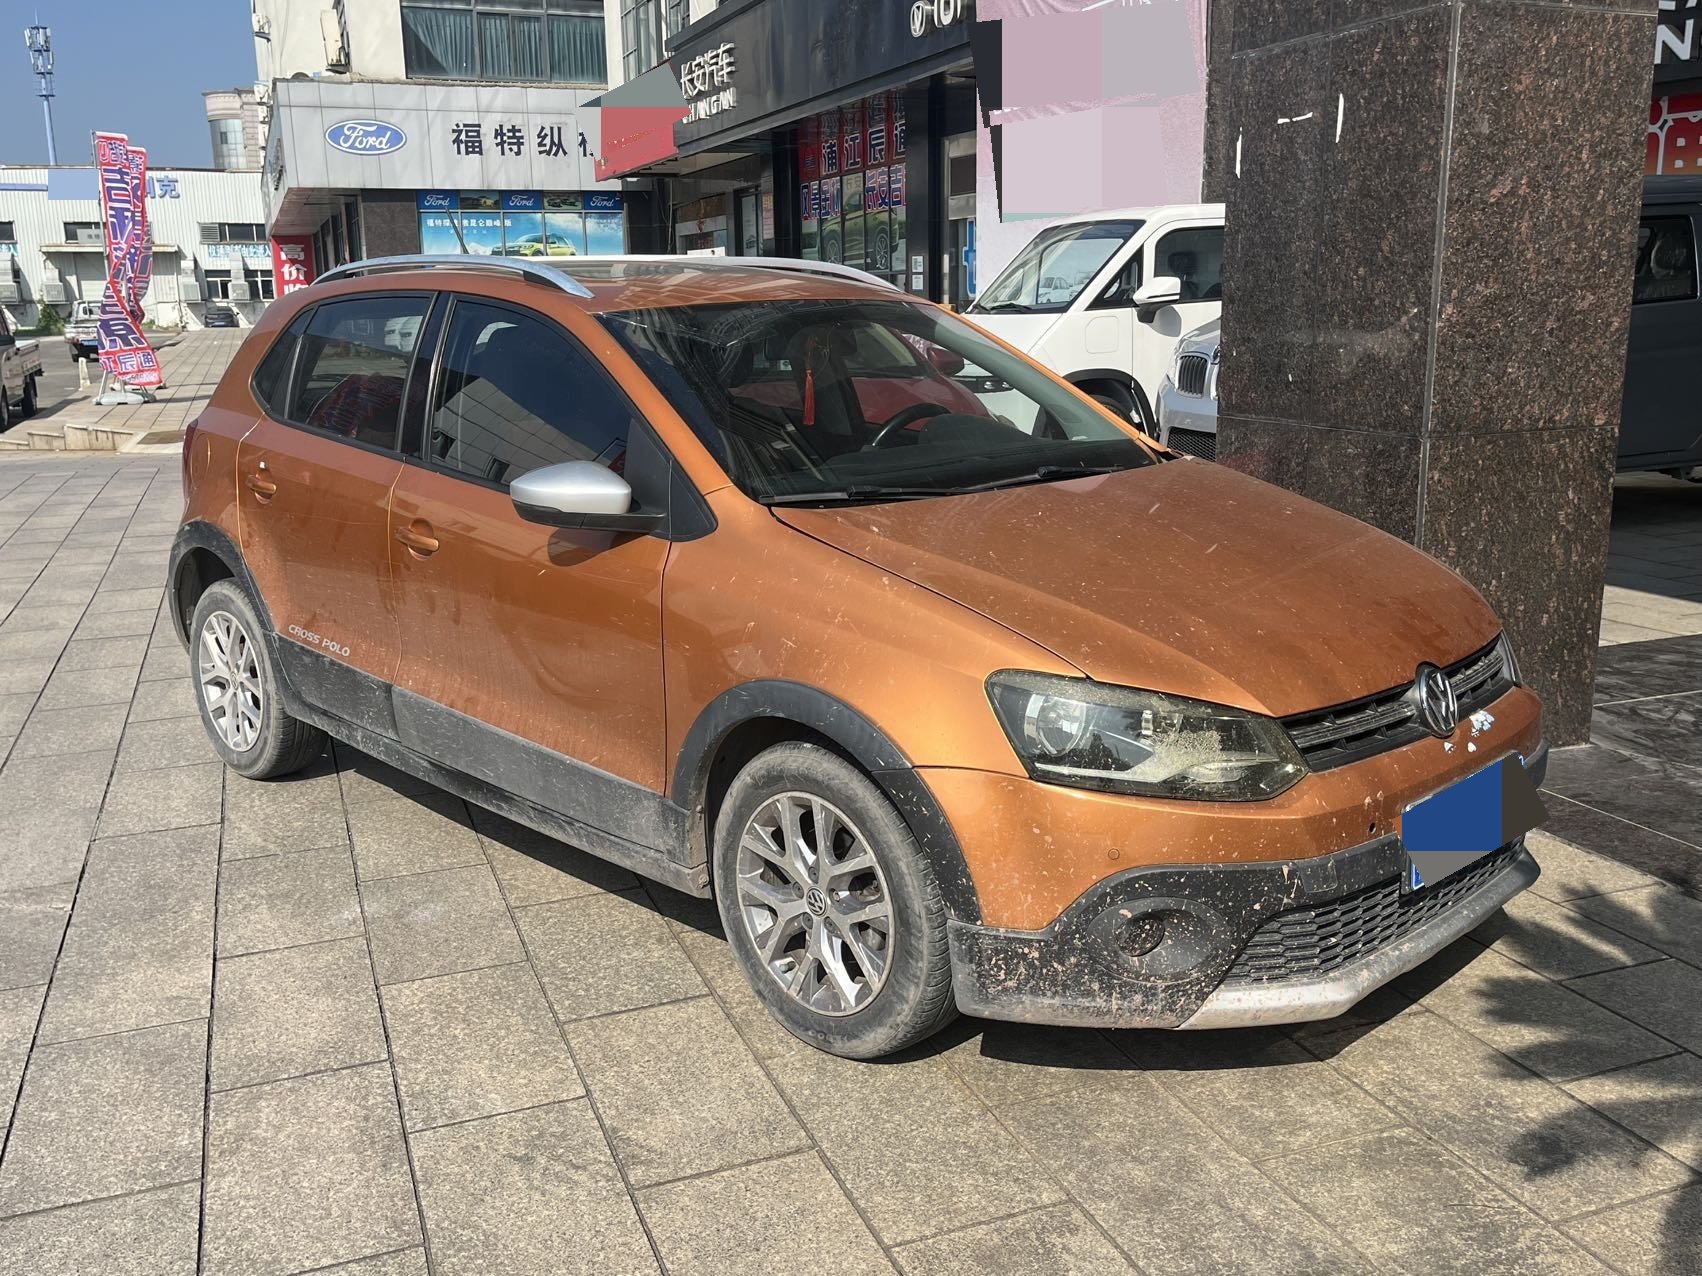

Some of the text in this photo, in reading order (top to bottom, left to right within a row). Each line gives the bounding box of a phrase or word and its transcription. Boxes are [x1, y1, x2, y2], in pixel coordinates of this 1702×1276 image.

[680, 42, 736, 99] 长安汽车
[682, 87, 737, 124] HANGAN
[339, 123, 392, 150] Ford
[424, 195, 450, 206] Ford
[509, 195, 534, 206] Ford
[590, 196, 614, 207] Ford
[288, 624, 351, 657] CROSS POLO
